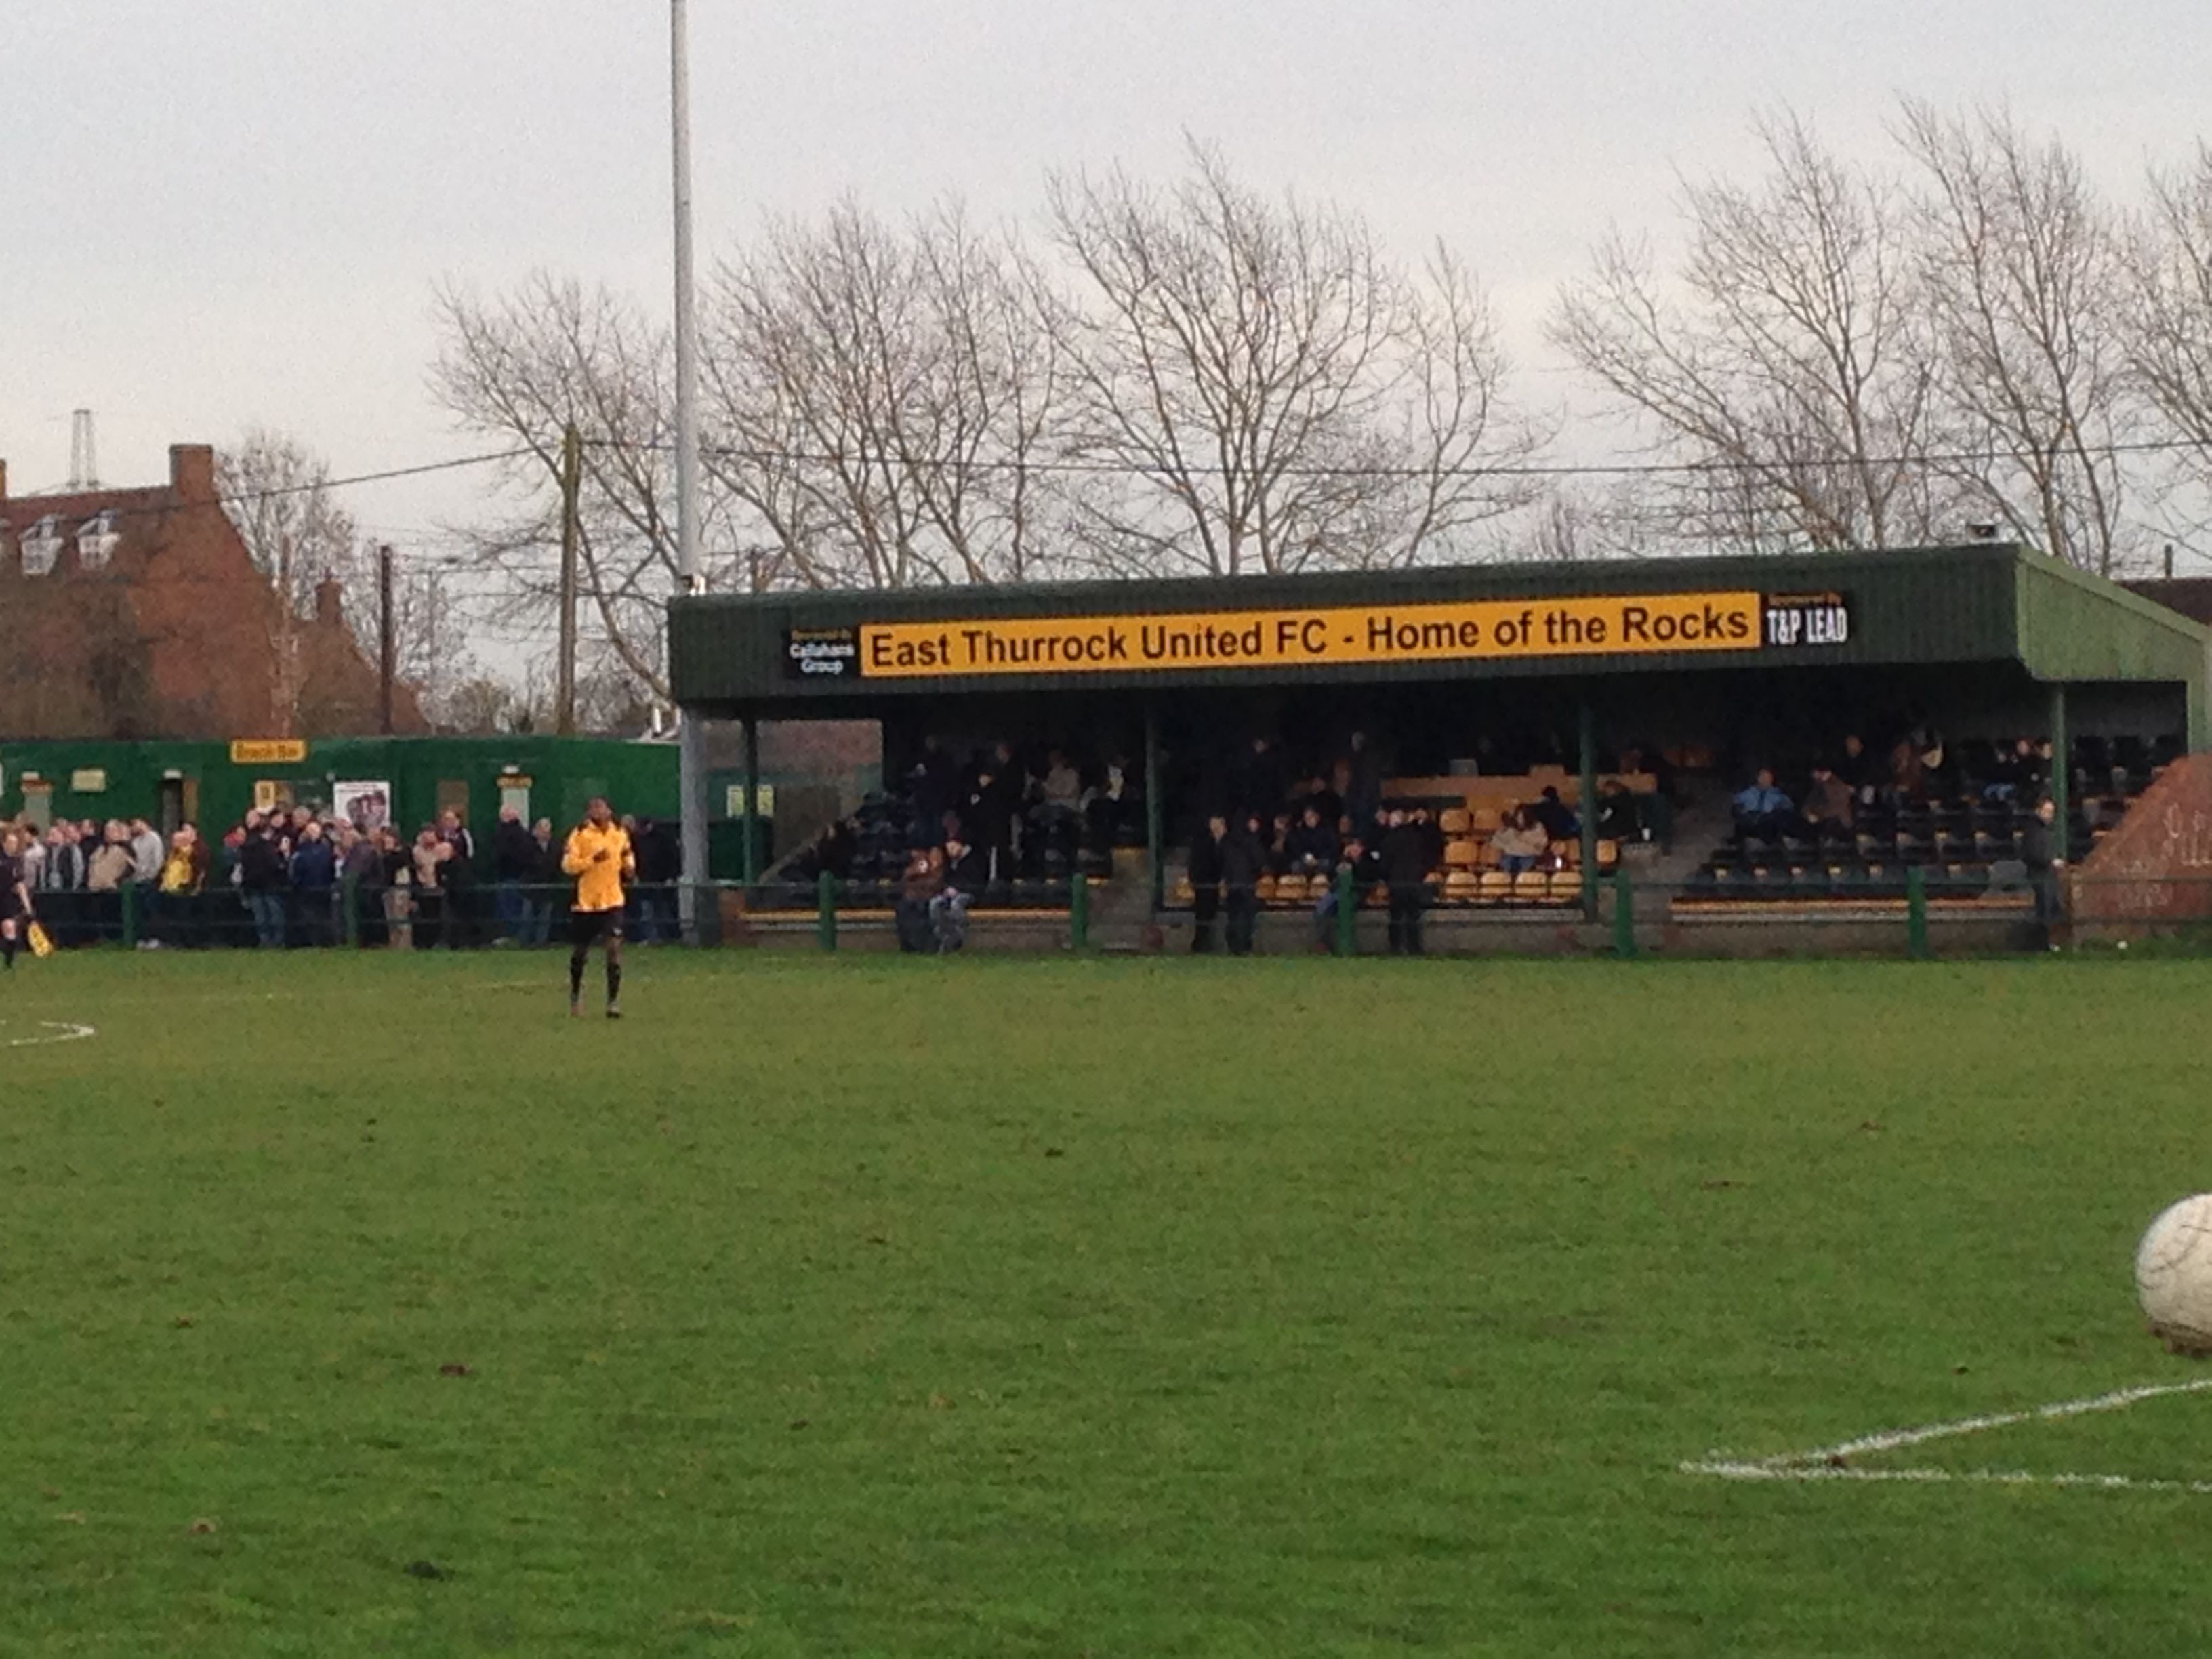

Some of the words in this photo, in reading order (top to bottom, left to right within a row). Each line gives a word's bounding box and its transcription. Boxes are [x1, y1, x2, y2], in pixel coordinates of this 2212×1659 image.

[871, 632, 949, 667] East
[961, 626, 1126, 663] Thurrock
[1141, 621, 1261, 659] United
[1277, 619, 1326, 654] FC
[1367, 615, 1479, 651] Home
[1494, 610, 1532, 647] of
[1544, 609, 1606, 644] the
[1622, 604, 1748, 642] Rocks
[1766, 609, 1801, 645] T&P
[1805, 607, 1847, 644] LEAD
